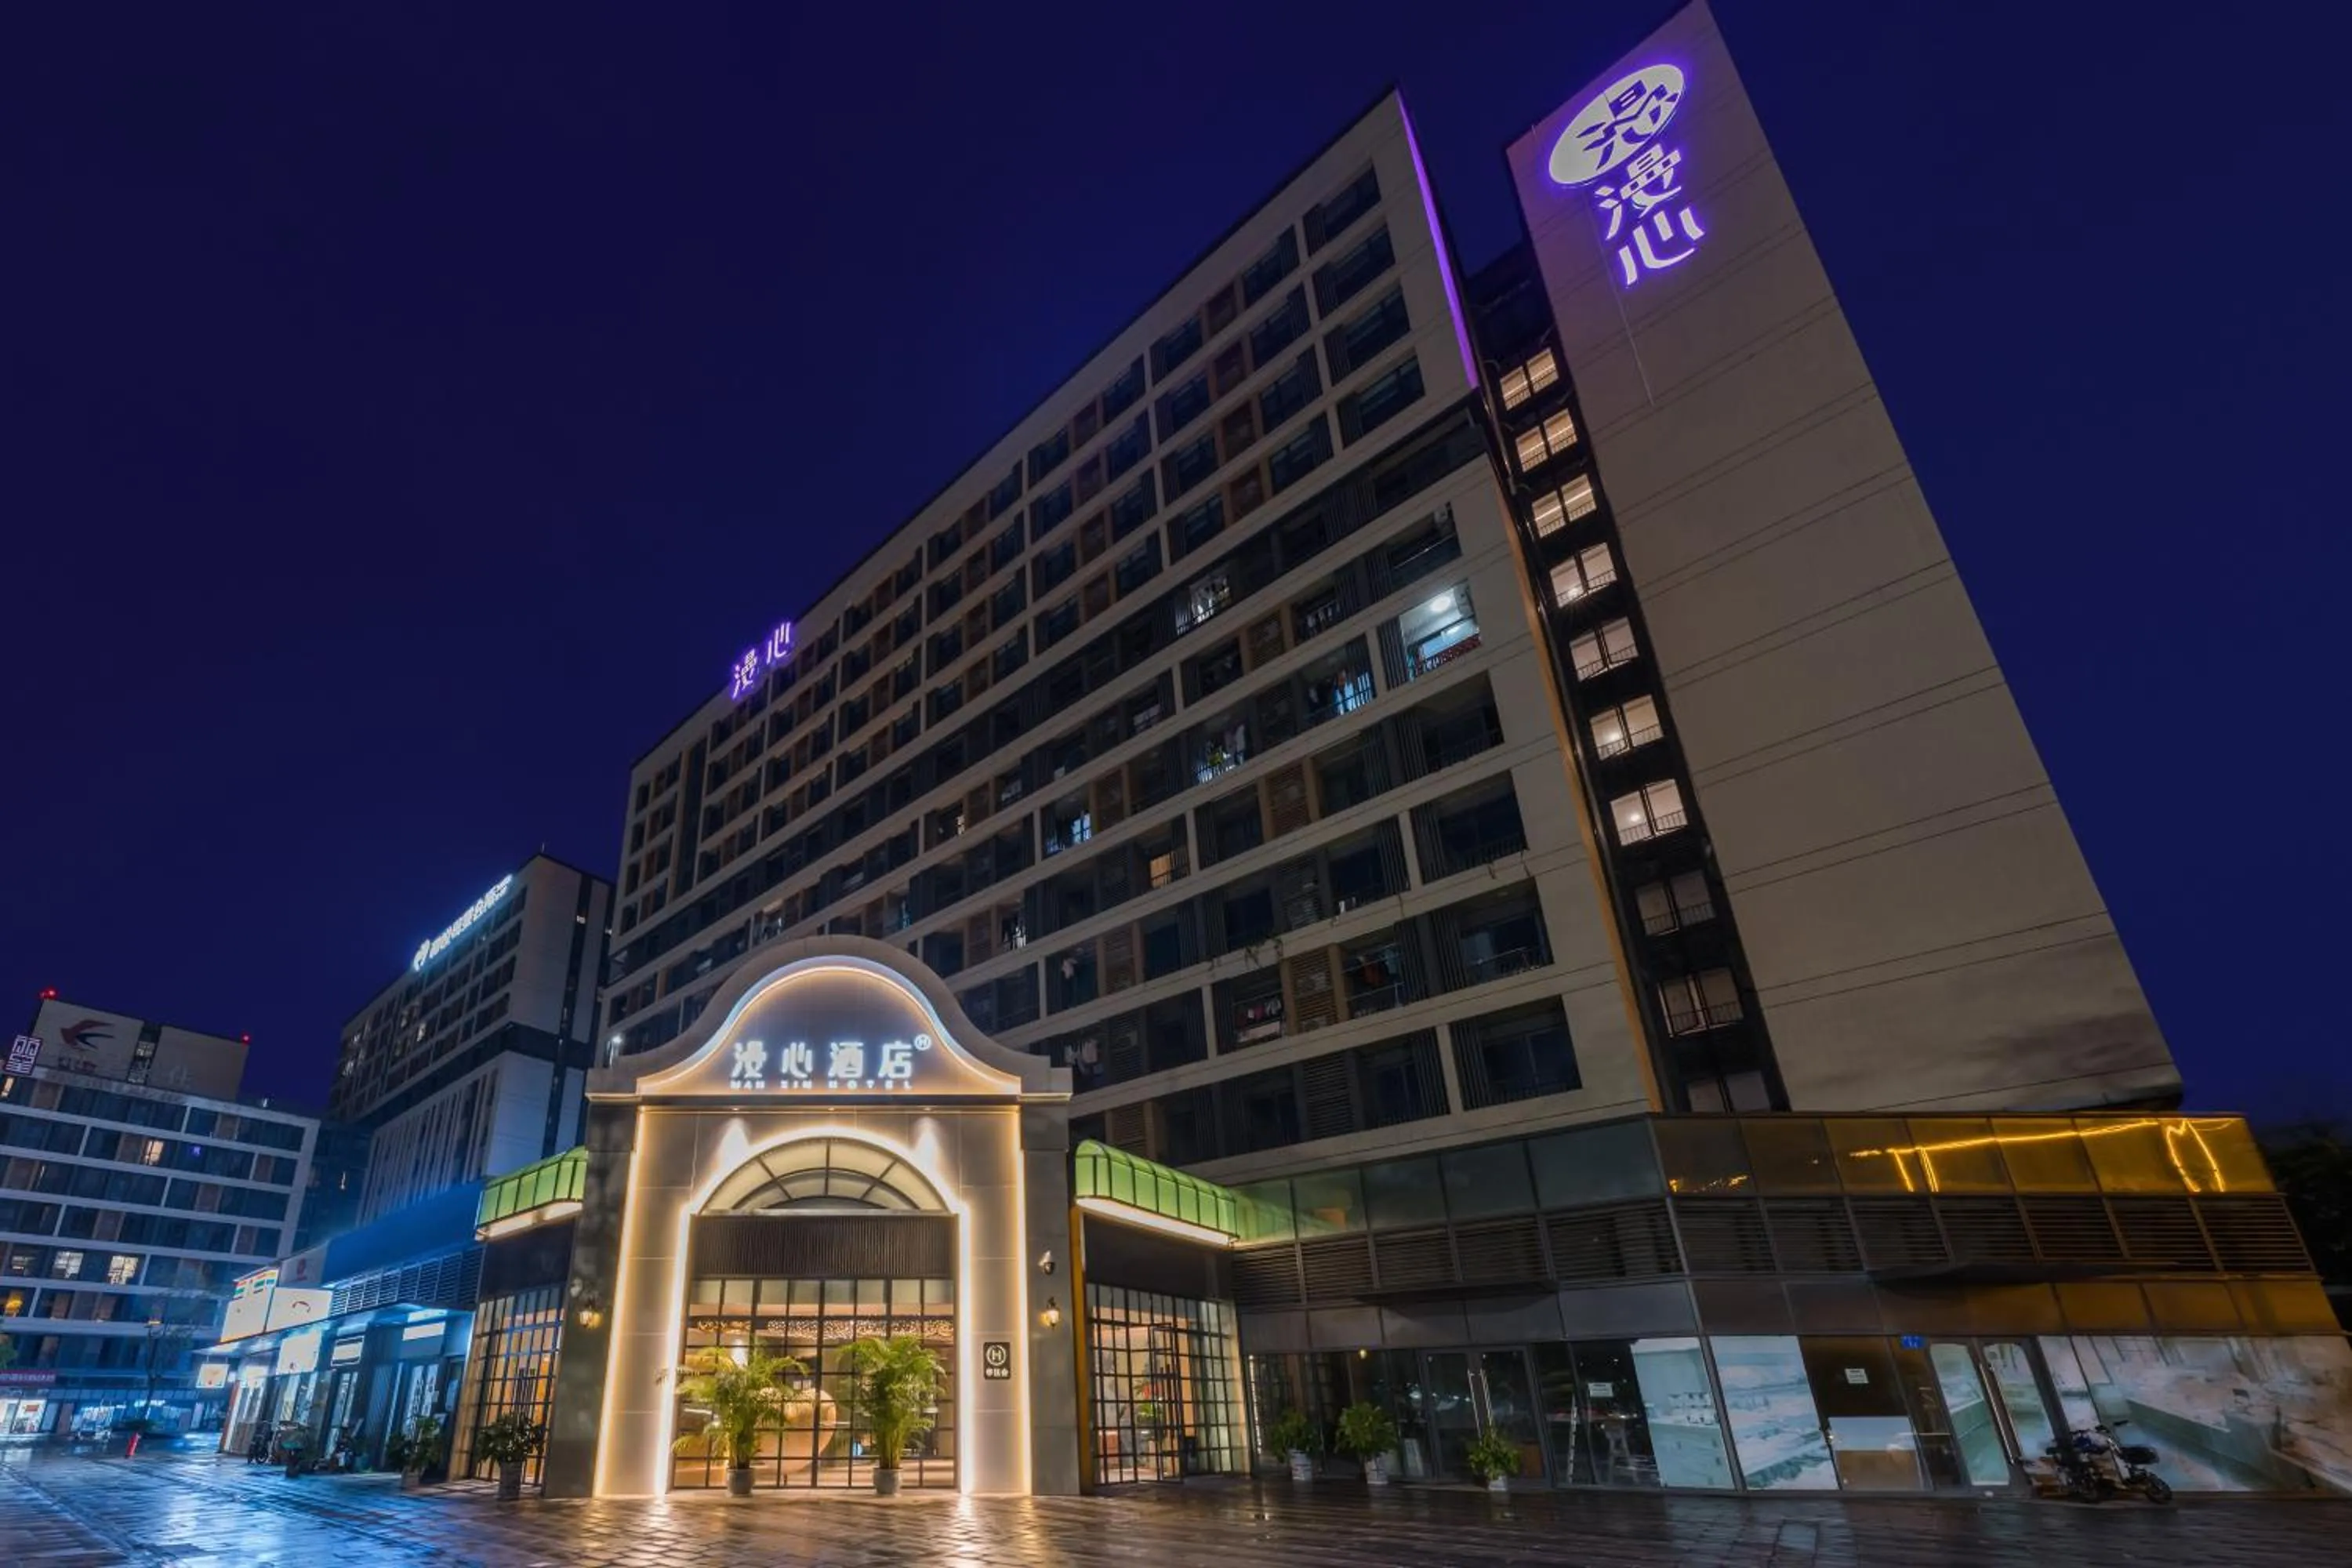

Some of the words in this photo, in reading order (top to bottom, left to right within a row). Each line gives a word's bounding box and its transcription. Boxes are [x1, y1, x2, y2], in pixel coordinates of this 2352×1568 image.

[1595, 144, 1705, 285] 漫心
[731, 622, 790, 699] 漫心
[731, 1040, 913, 1079] 漫心酒店
